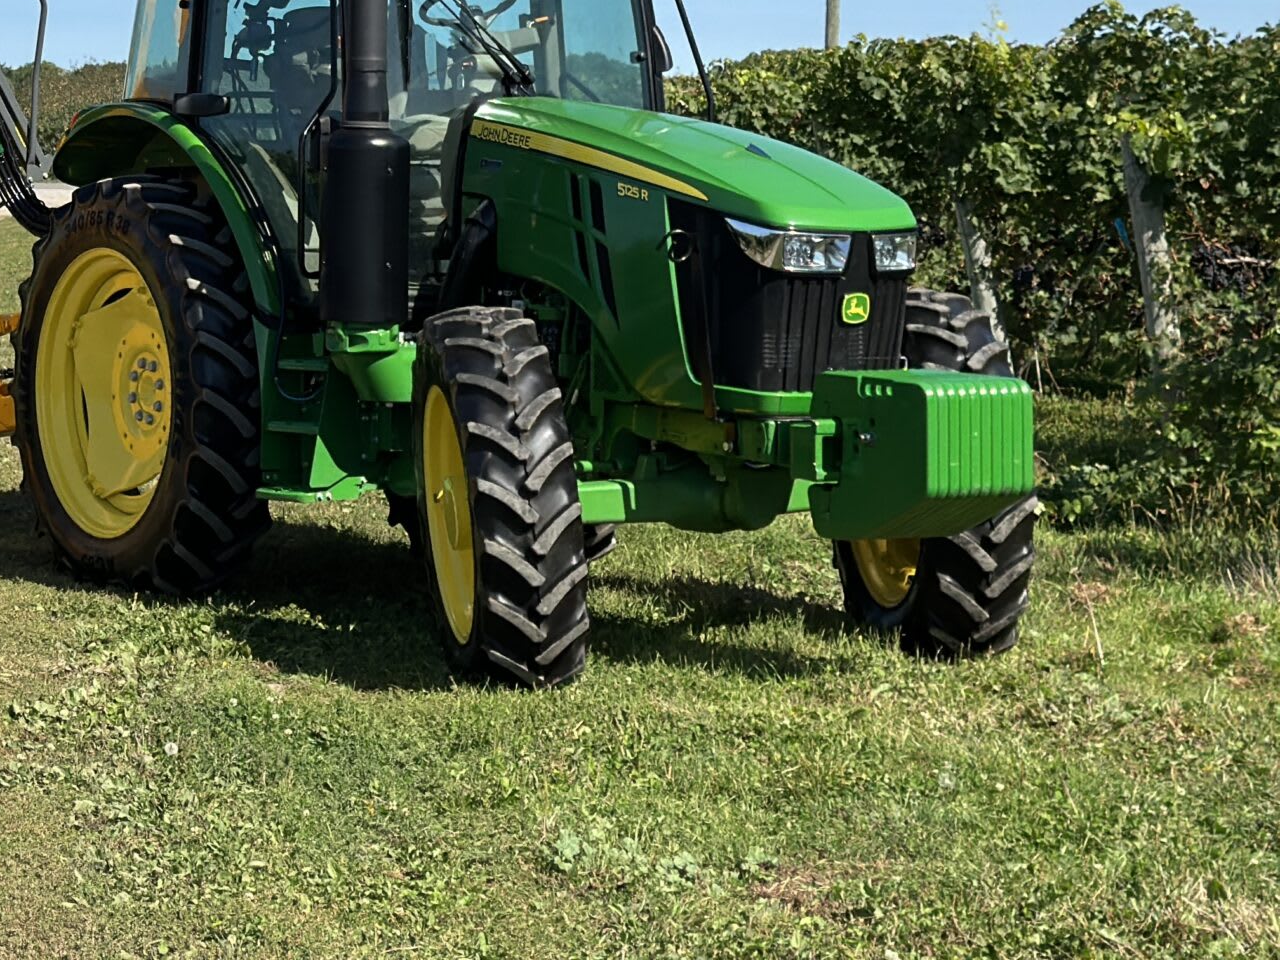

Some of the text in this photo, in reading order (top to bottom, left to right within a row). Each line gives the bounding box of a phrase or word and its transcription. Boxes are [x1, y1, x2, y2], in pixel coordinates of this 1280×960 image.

[477, 124, 532, 148] JOHN DEERE
[617, 181, 640, 199] 5125
